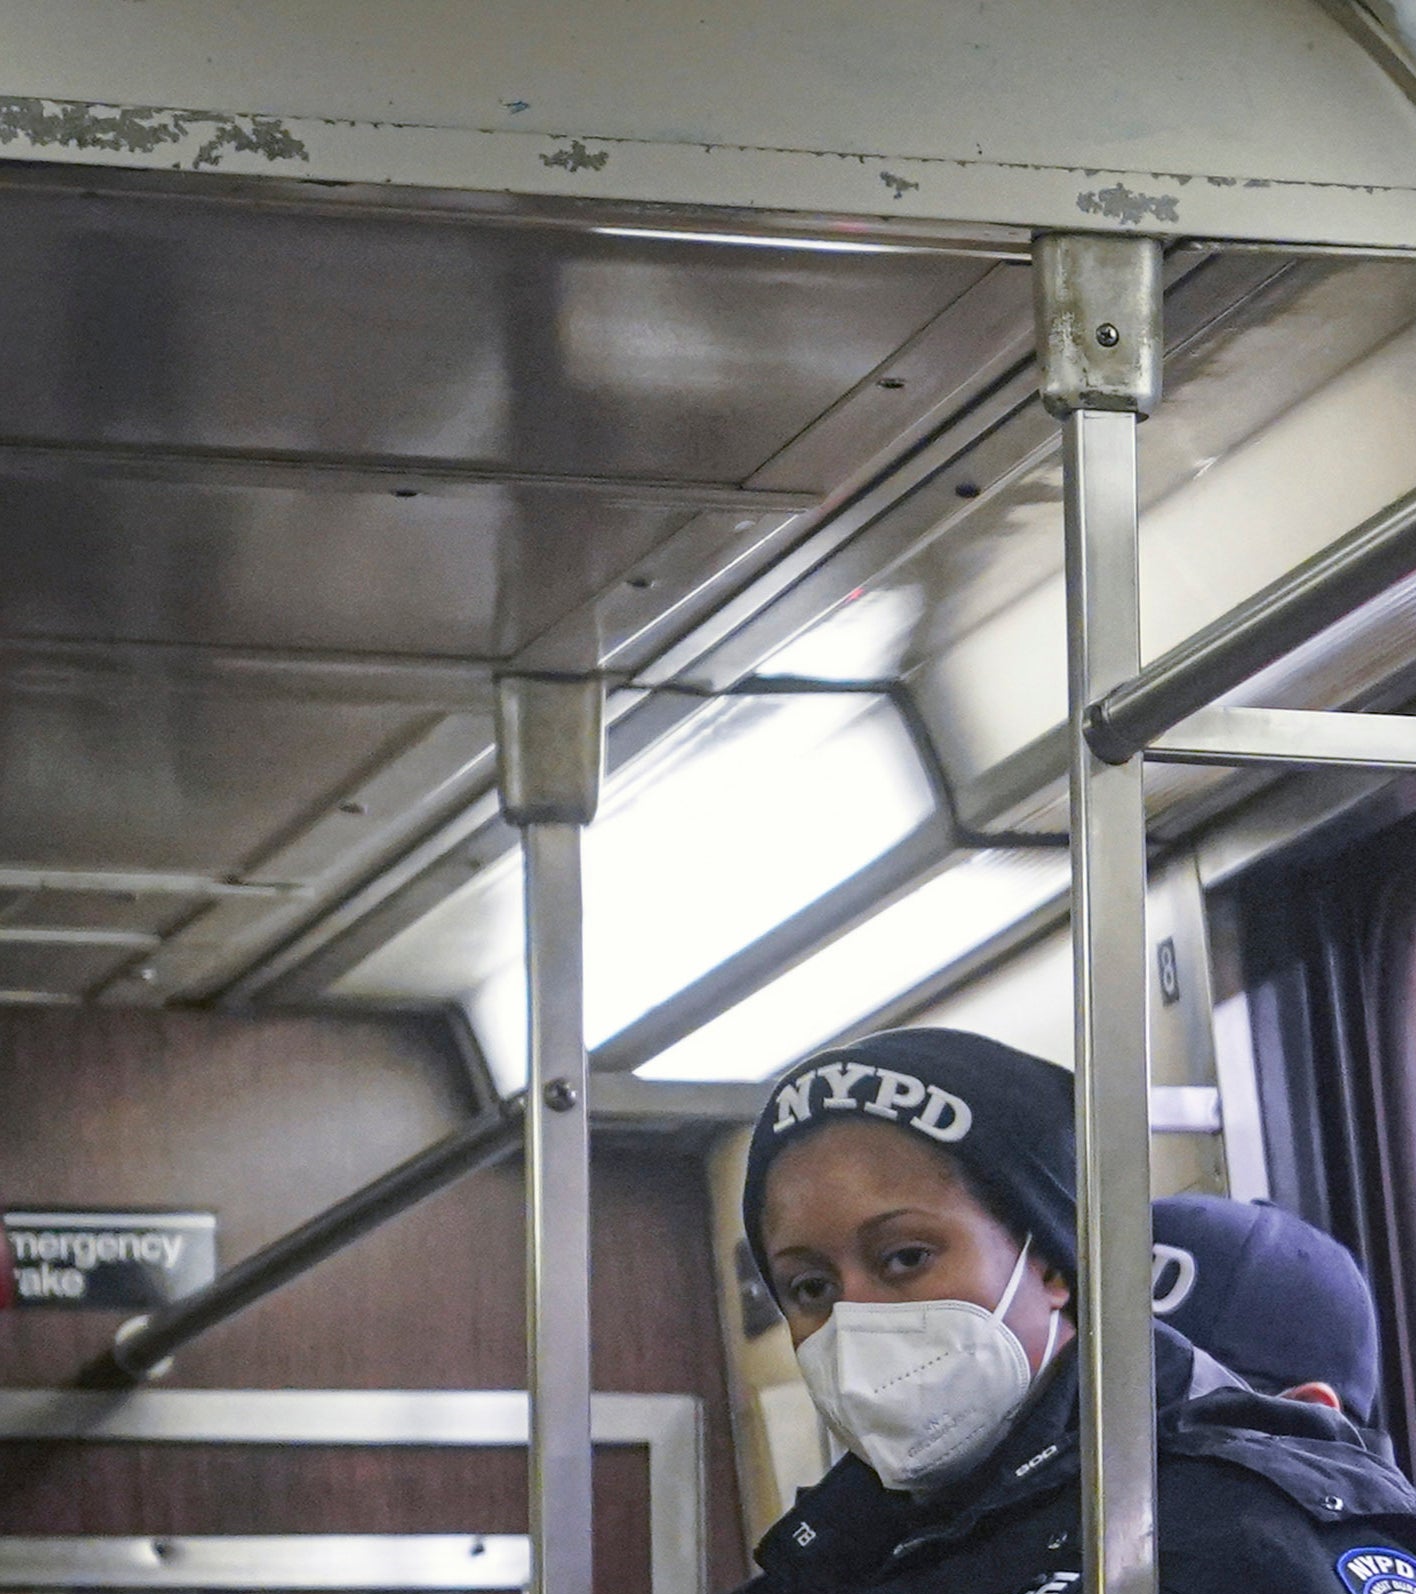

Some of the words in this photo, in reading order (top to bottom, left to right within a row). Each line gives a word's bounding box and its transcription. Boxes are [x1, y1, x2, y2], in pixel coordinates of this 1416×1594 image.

[773, 1062, 972, 1143] NYPD
[8, 1231, 183, 1269] mergency
[1347, 1555, 1414, 1581] NYPD
